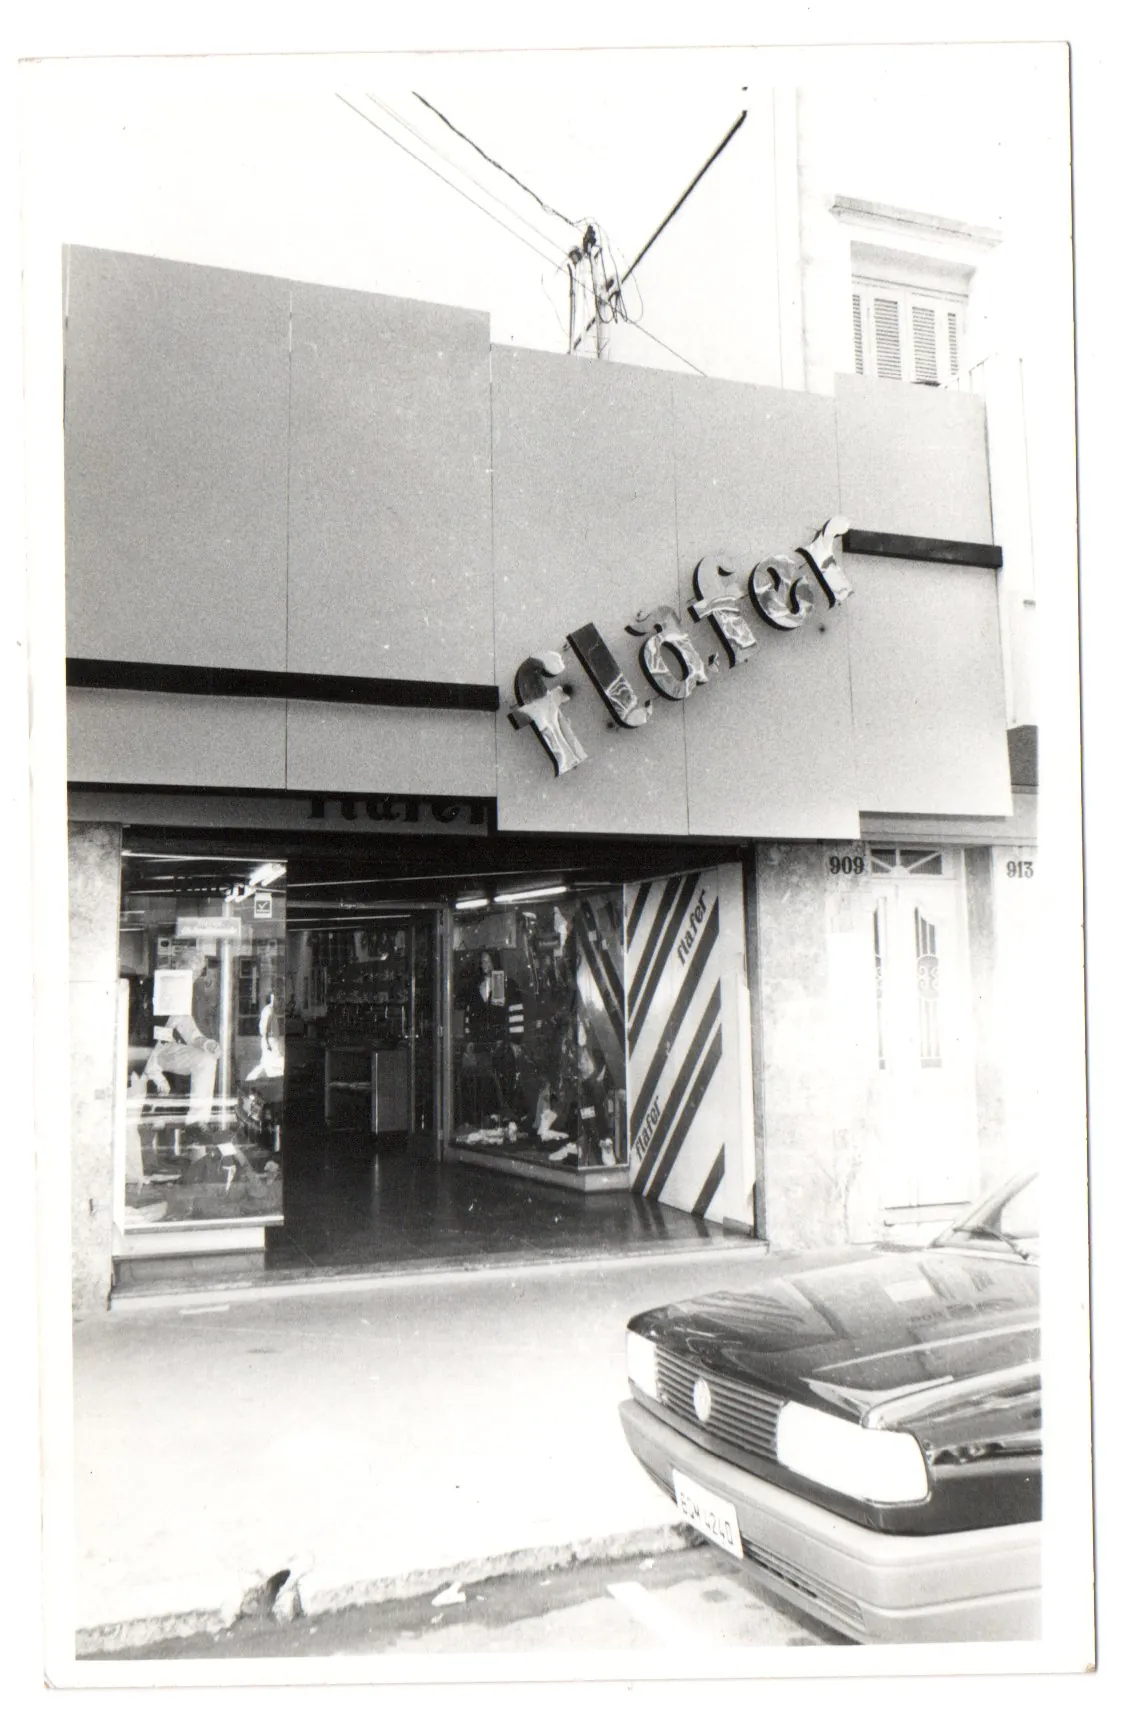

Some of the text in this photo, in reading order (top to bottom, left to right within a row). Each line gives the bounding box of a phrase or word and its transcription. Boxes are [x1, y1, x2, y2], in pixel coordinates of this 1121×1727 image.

[829, 856, 865, 875] 909
[1006, 860, 1034, 878] 913
[677, 889, 706, 967] flafer
[635, 1096, 660, 1161] flafer
